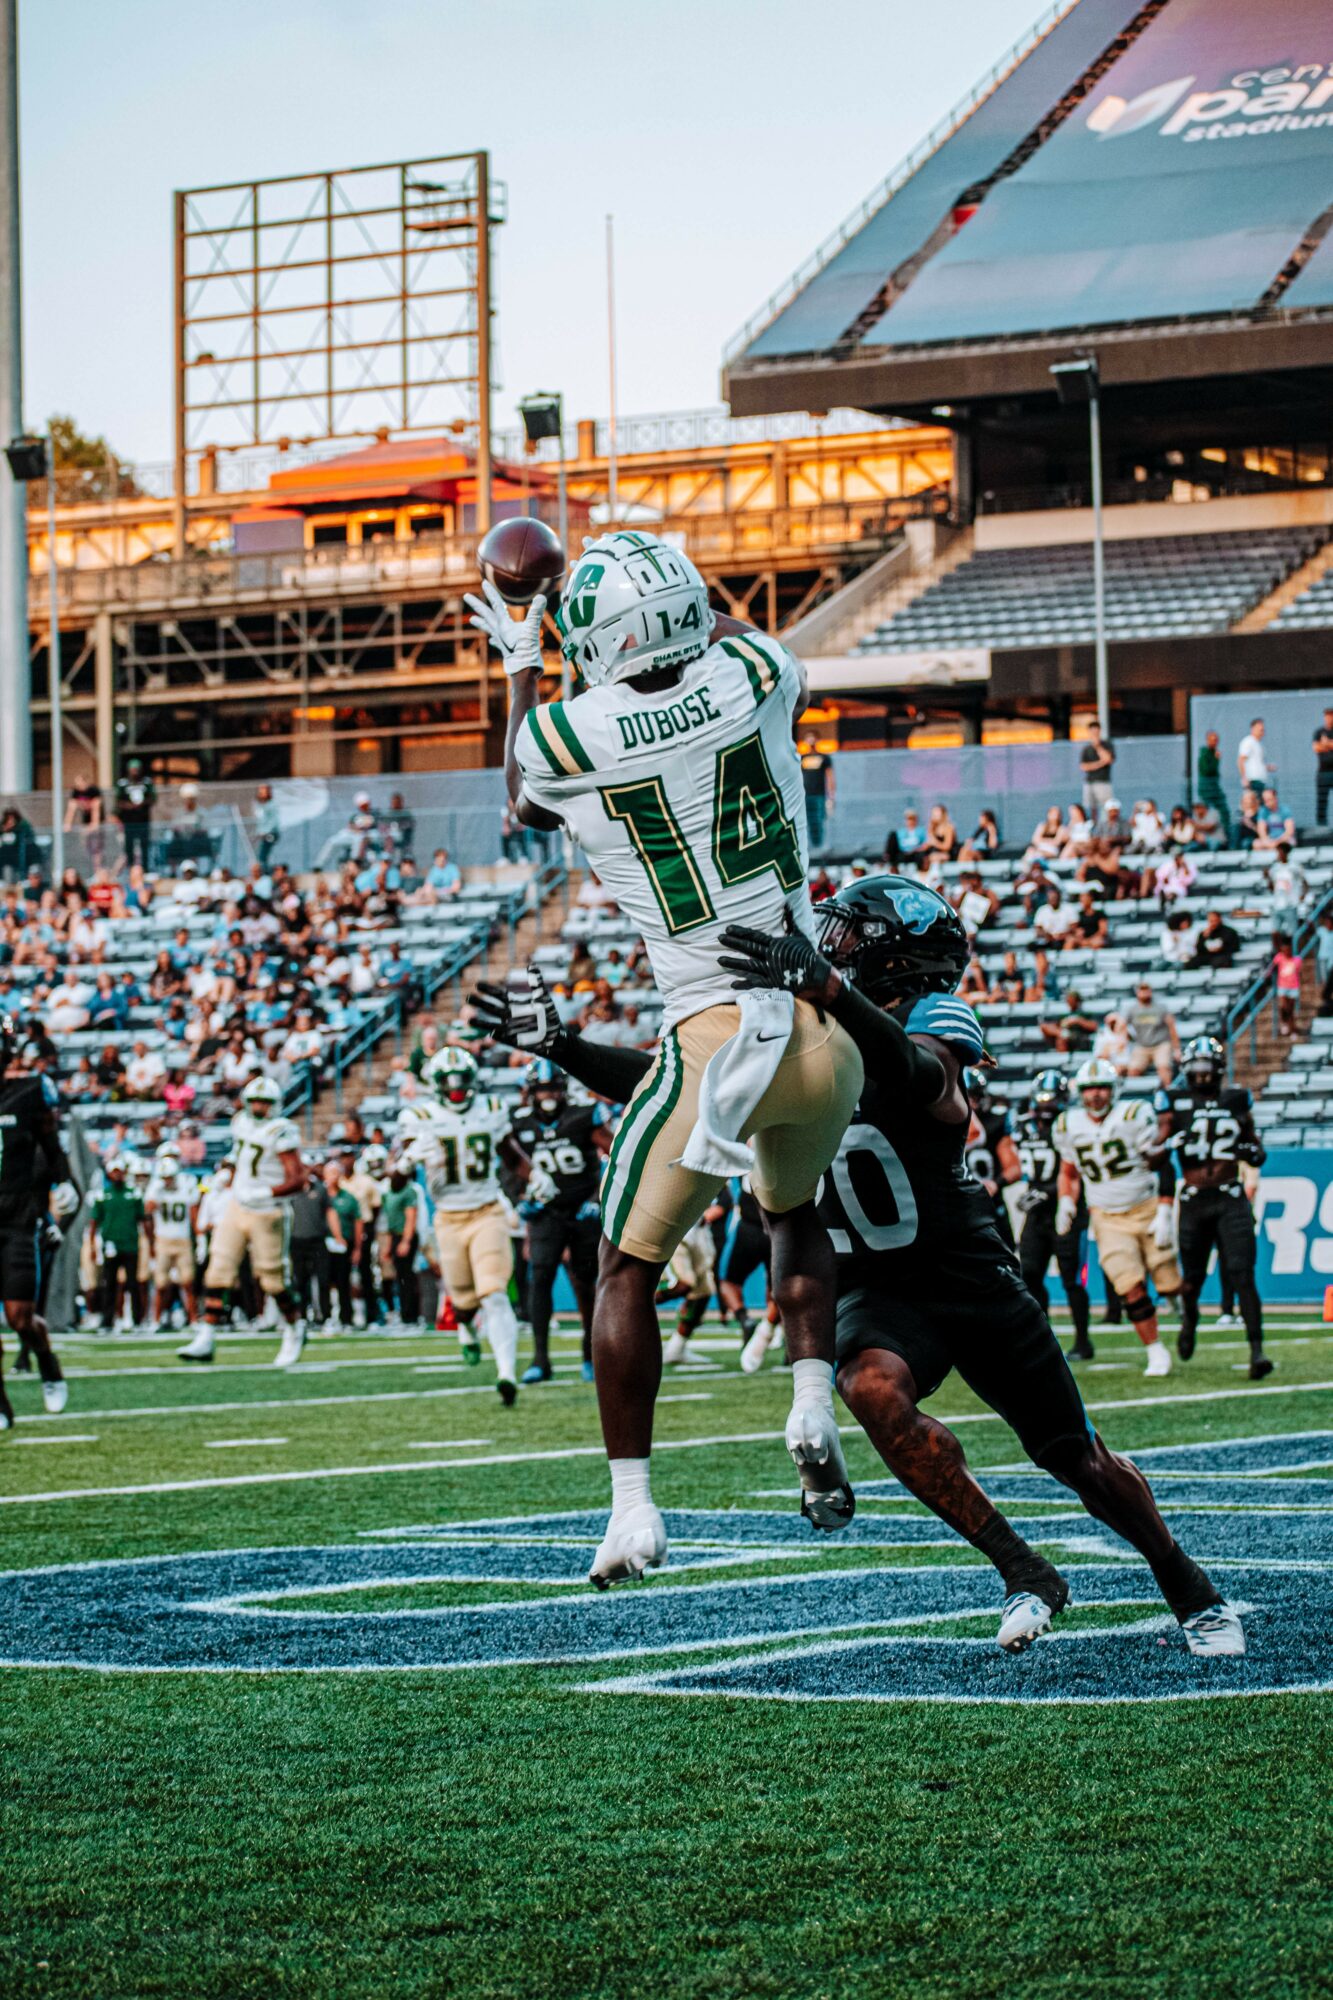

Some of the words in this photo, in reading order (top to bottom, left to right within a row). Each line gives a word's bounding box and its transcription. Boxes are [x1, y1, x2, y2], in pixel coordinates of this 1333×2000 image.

[1231, 62, 1333, 88] cen
[617, 686, 722, 750] DUBOSE
[597, 728, 806, 937] 14
[438, 1132, 491, 1184] 13
[1073, 1138, 1135, 1182] 52
[1184, 1117, 1241, 1161] 42
[815, 1123, 919, 1253] 0
[1018, 1148, 1056, 1182] 97
